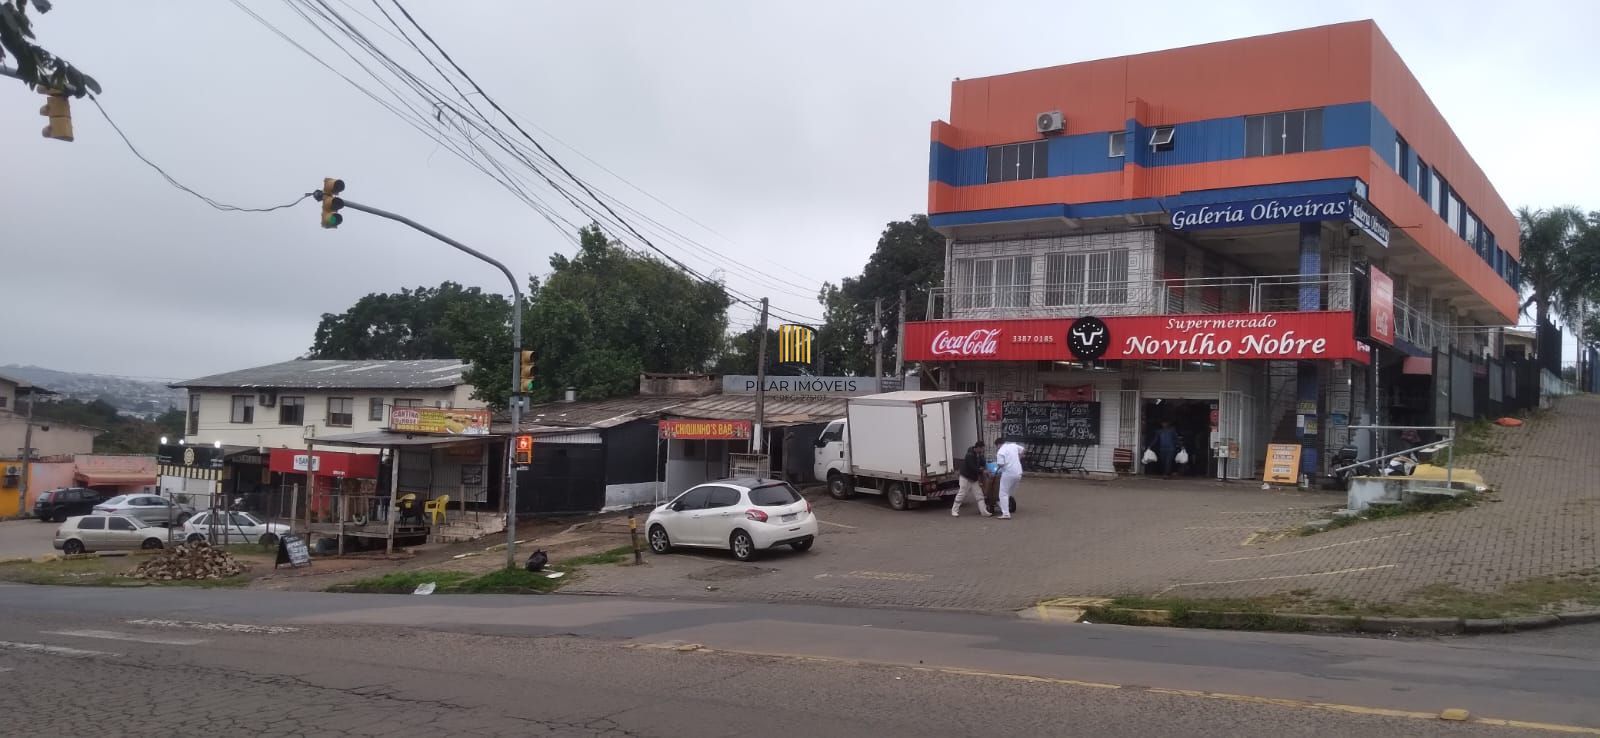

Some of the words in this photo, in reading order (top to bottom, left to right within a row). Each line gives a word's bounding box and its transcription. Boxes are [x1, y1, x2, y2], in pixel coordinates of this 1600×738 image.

[1172, 205, 1245, 230] Galeria
[1250, 199, 1346, 221] Oliveiras
[1166, 314, 1277, 333] Supermercado
[931, 328, 1002, 355] Coca-Cola
[1122, 332, 1232, 356] Novilho
[1238, 331, 1327, 355] Nobre
[718, 423, 733, 435] BAR
